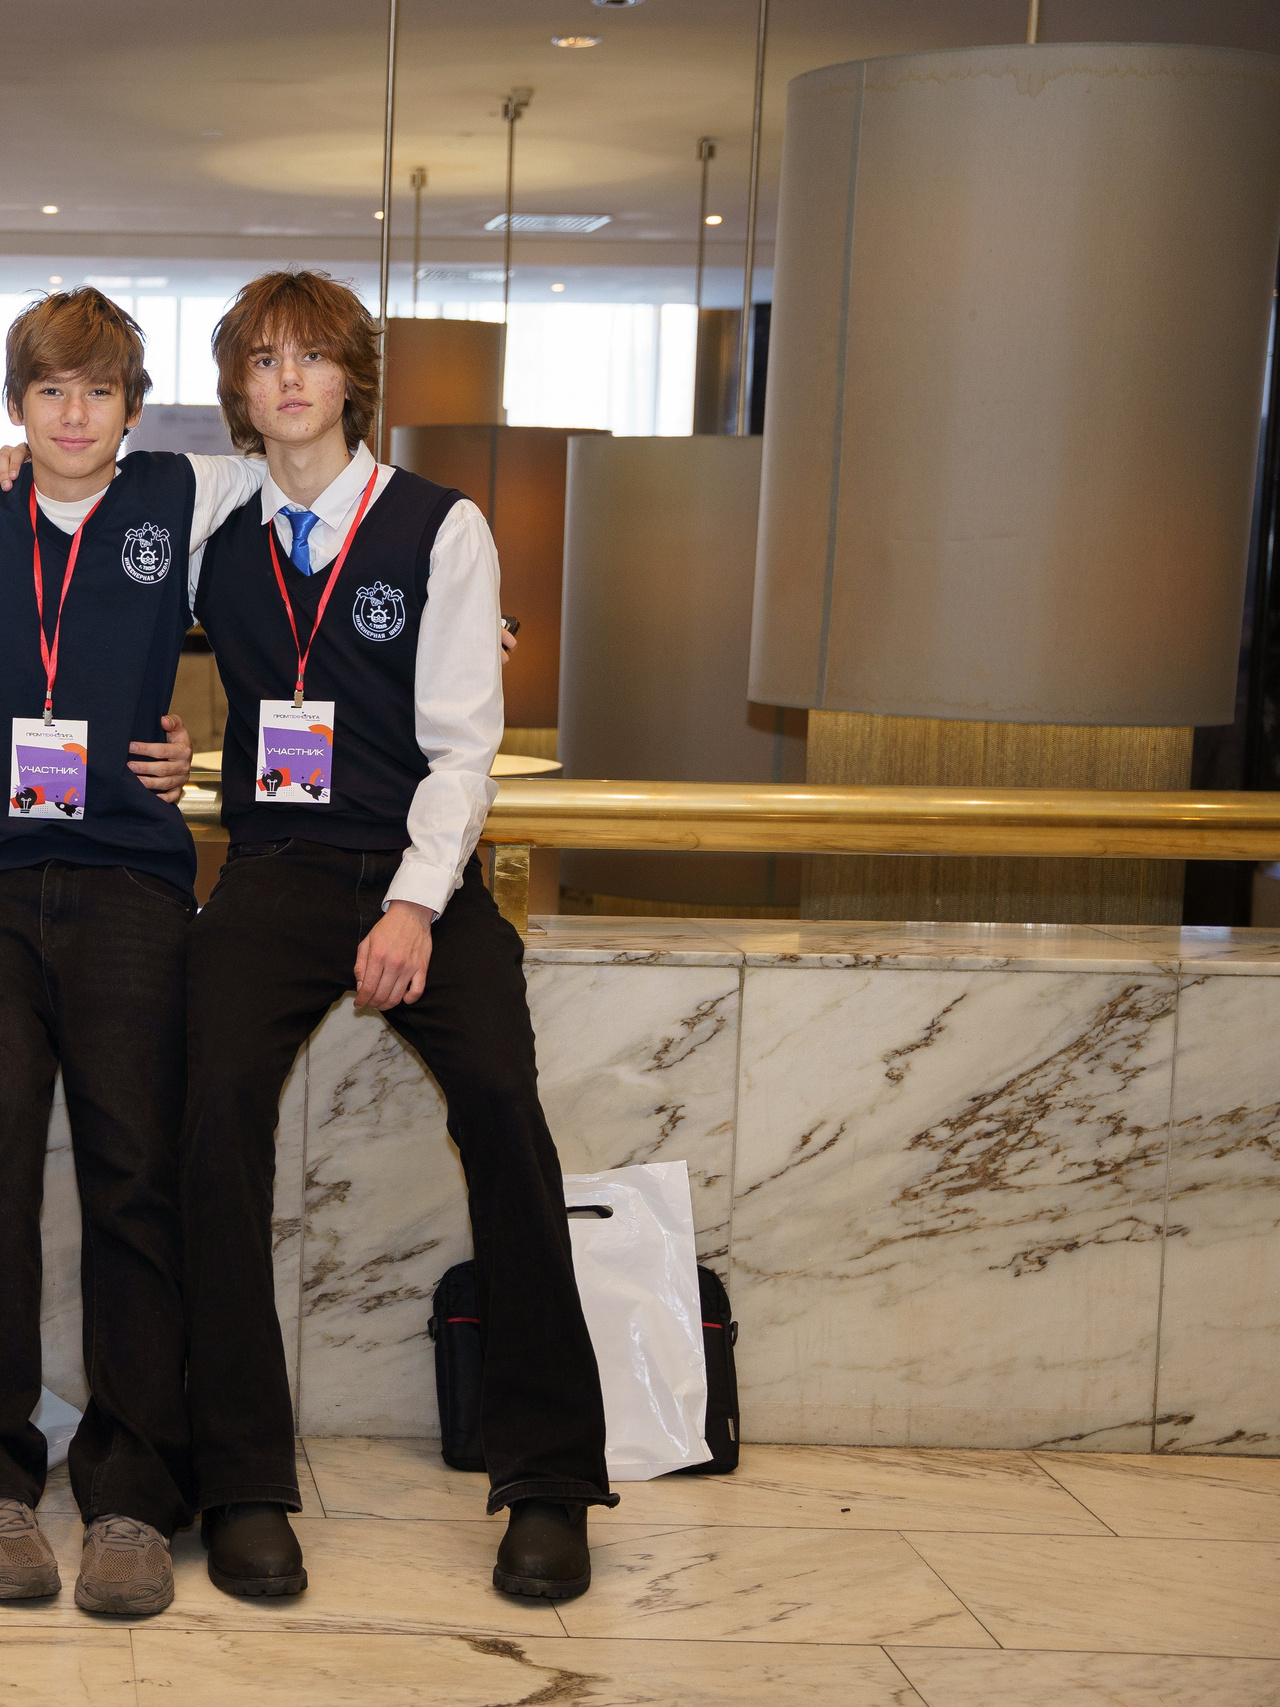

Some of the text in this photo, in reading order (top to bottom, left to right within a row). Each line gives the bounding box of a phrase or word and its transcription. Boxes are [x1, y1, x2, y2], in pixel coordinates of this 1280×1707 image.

[124, 557, 170, 581] ИНЖЕНЕРНАЯ ШКОЛА
[355, 614, 403, 639] ИНЖЕНЕРНАЯ ШКОЛА
[266, 747, 324, 757] УЧАСТНИК
[19, 765, 78, 776] УЧАСТНИК
